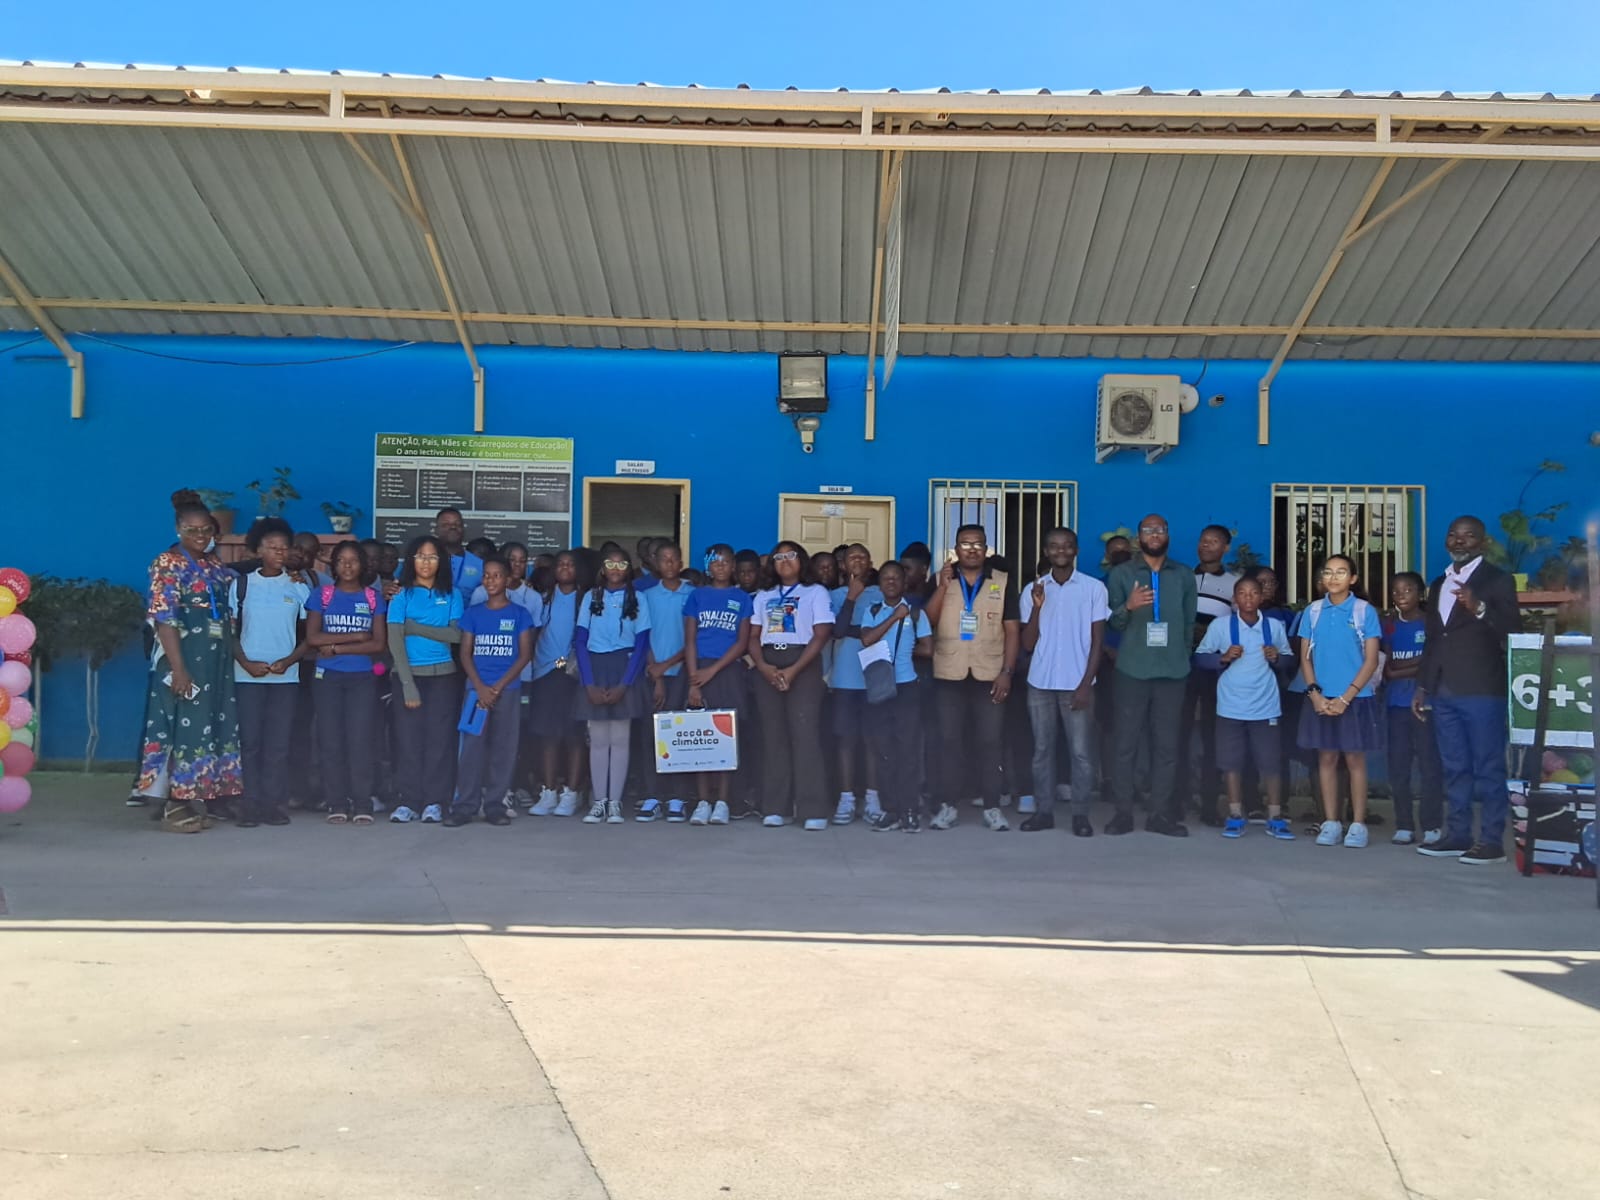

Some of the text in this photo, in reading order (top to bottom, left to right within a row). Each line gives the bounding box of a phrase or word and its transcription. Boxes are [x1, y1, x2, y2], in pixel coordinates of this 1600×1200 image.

[1160, 404, 1173, 412] LG
[381, 436, 420, 447] ATENÇÃO,
[441, 438, 460, 447] Mães
[468, 440, 520, 449] Encarregados
[521, 441, 529, 449] de
[419, 448, 445, 456] lectivo
[671, 738, 719, 746] climática
